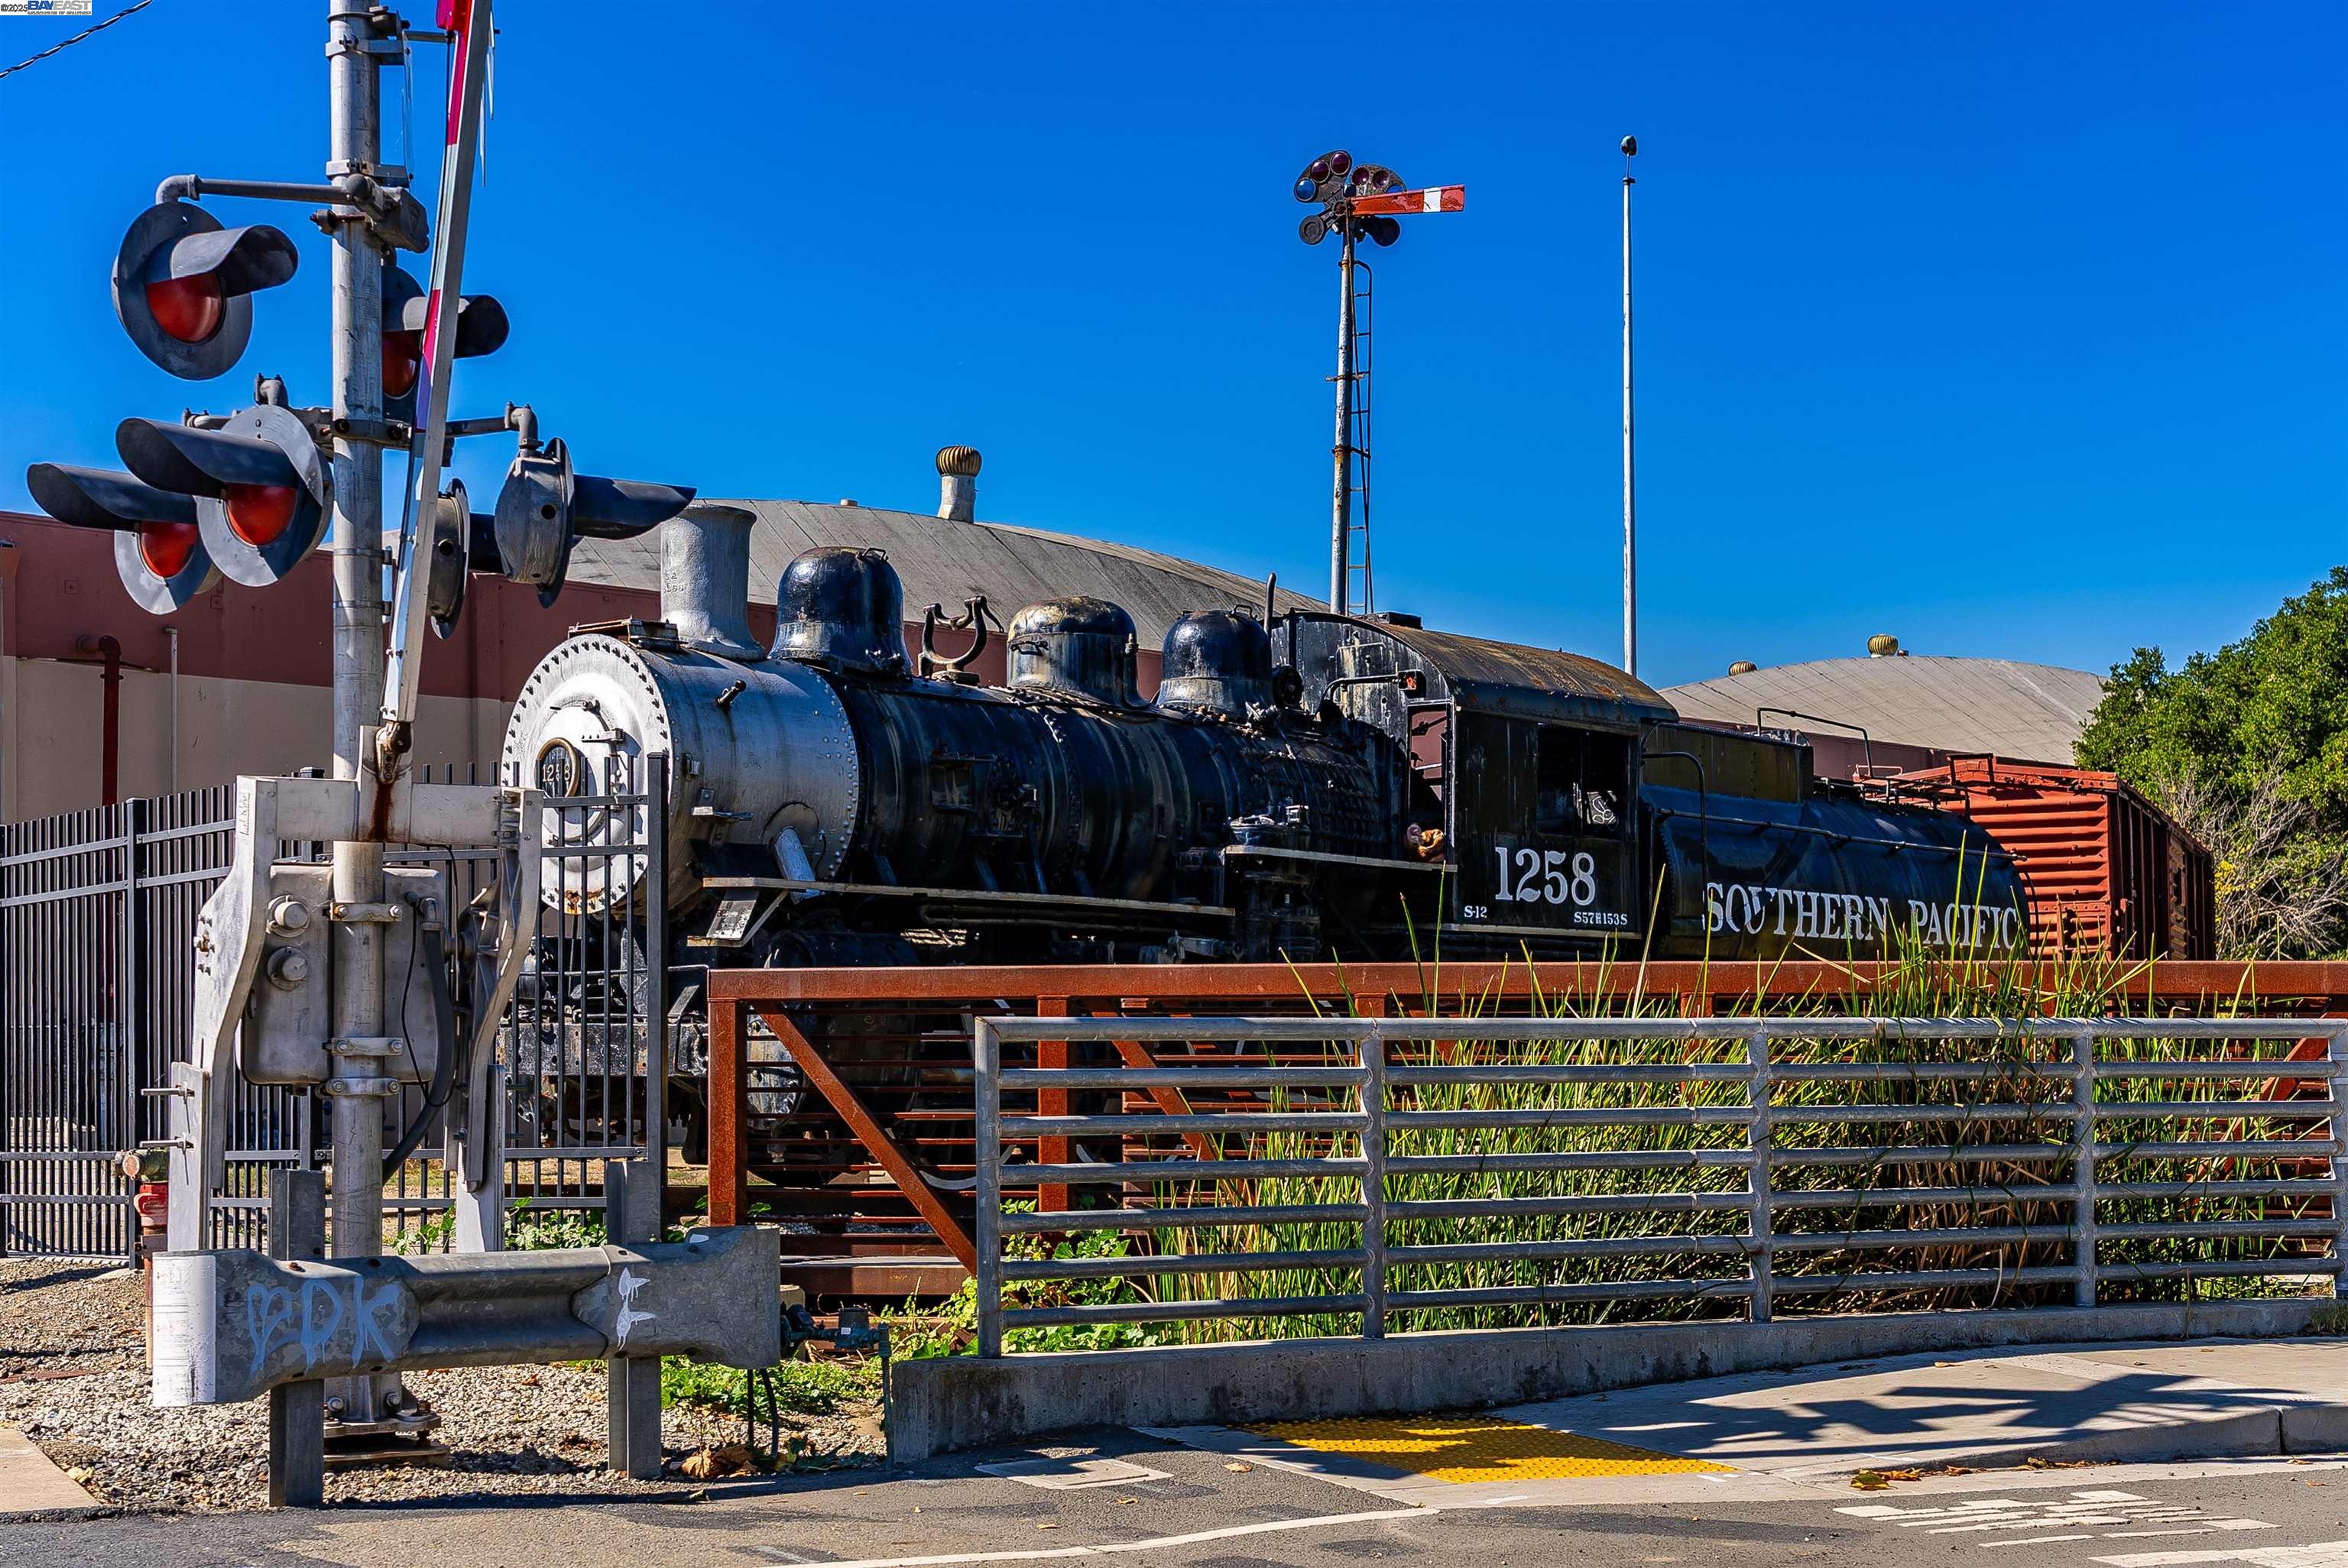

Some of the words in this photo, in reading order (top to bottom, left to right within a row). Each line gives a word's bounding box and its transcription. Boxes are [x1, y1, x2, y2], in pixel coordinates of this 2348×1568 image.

[1494, 846, 1596, 906] 1258
[1701, 882, 1889, 941] SOUTHERN
[1908, 899, 2017, 949] PACIFIC
